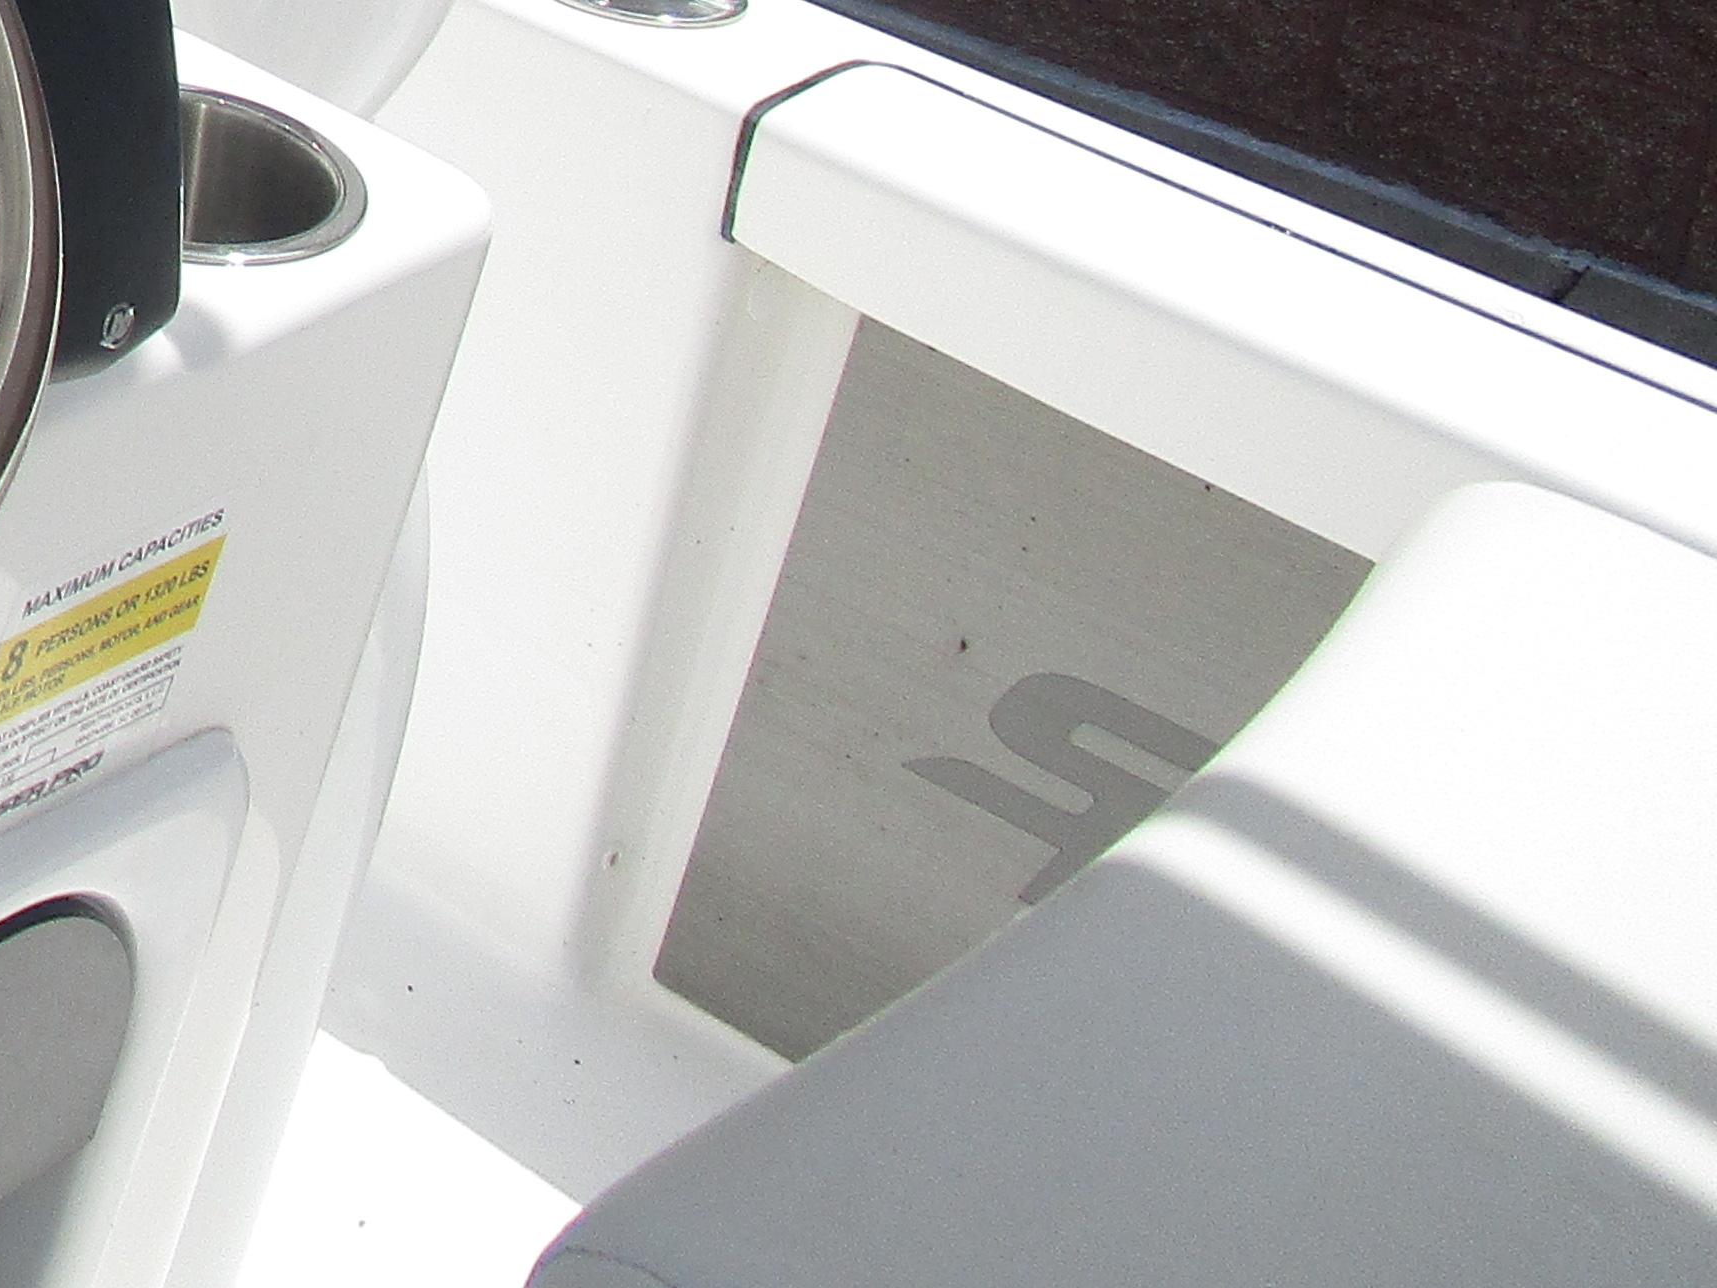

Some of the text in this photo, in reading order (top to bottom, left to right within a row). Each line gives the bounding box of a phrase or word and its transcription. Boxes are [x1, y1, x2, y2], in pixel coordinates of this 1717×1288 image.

[22, 507, 225, 620] MAXIMUM CAPACITIES
[1, 639, 30, 683] 8
[35, 604, 116, 658] PERSONS
